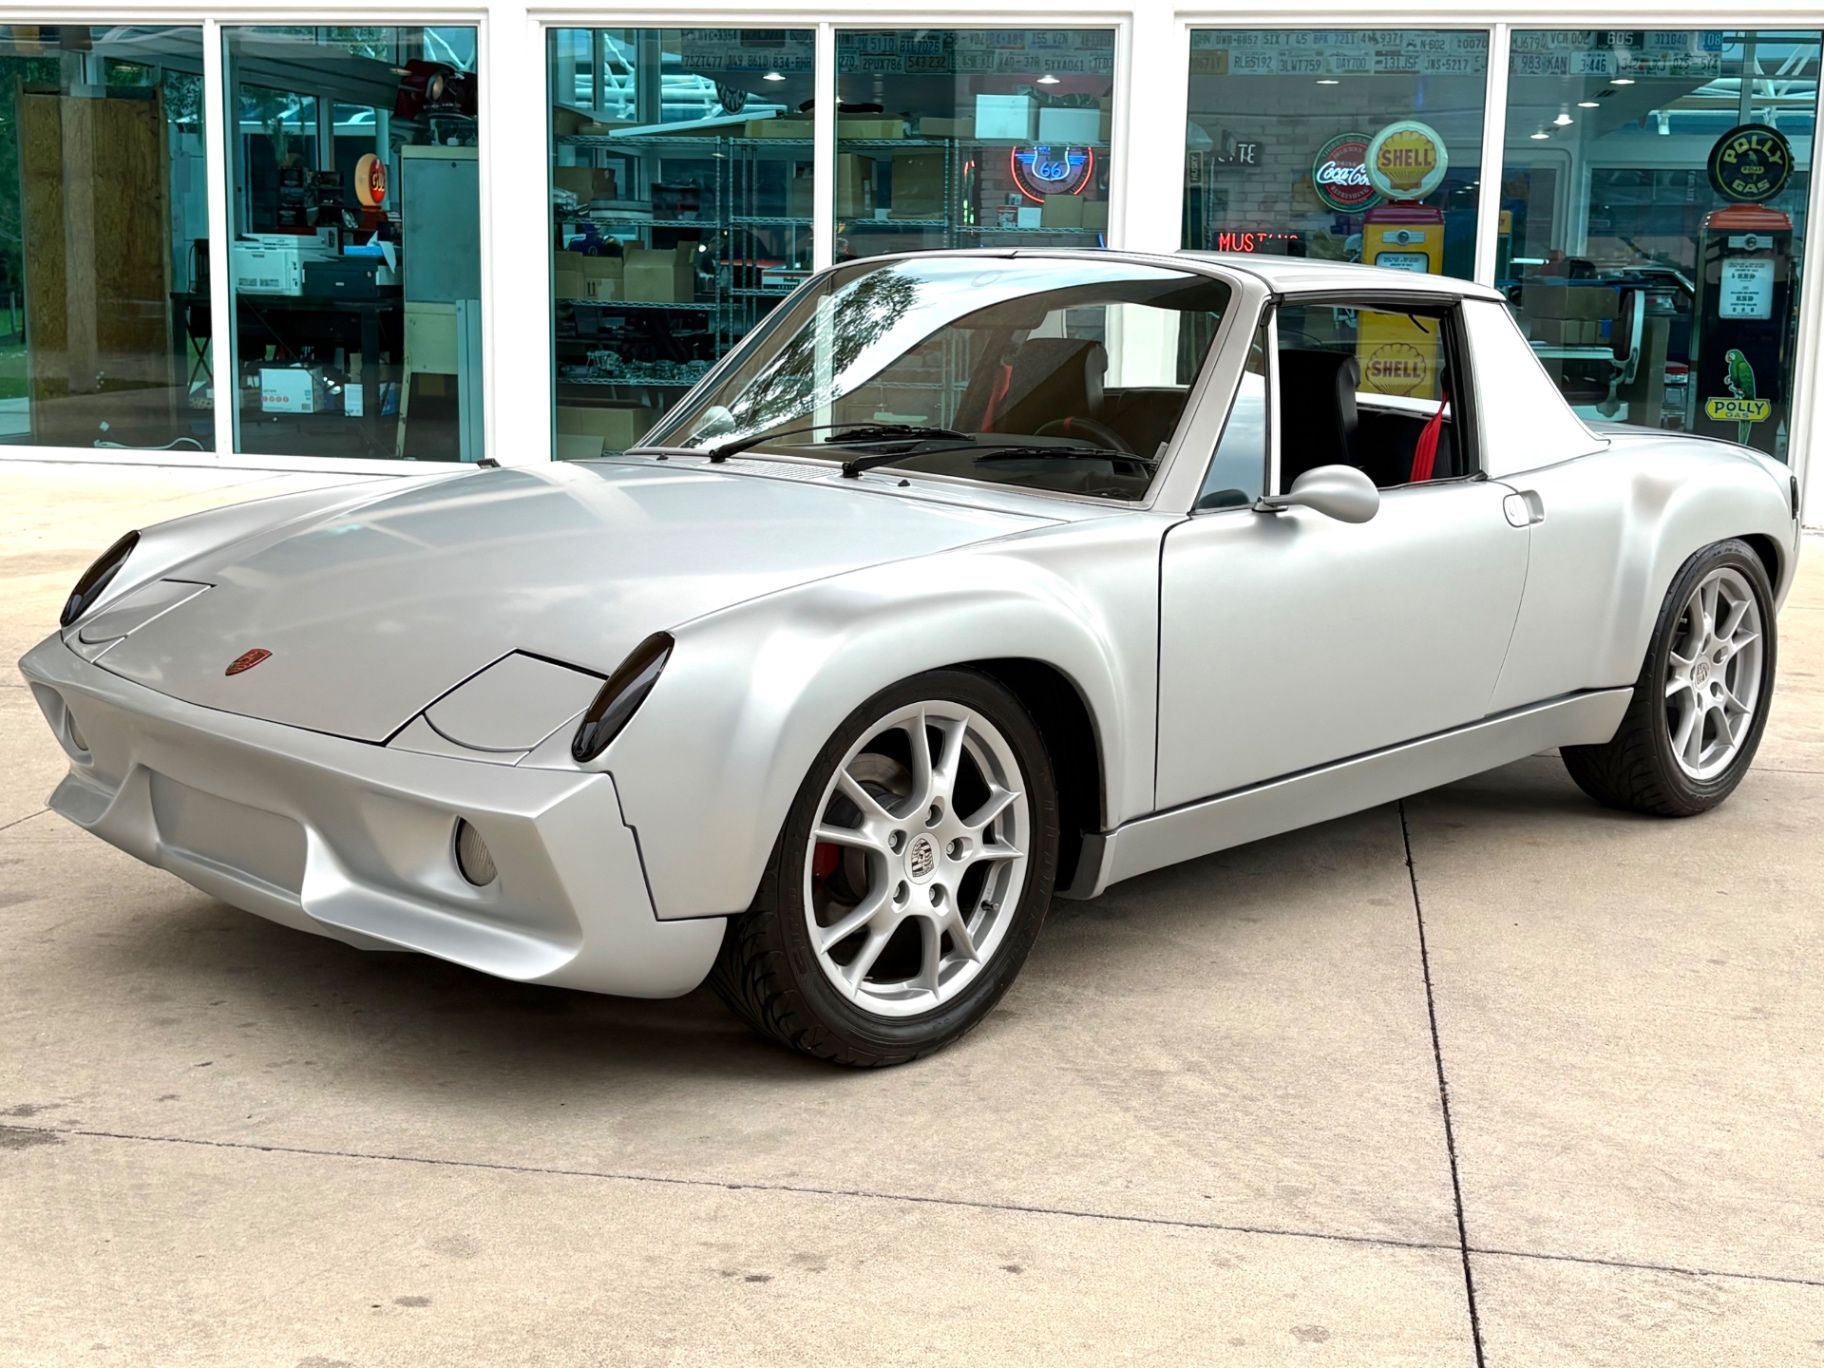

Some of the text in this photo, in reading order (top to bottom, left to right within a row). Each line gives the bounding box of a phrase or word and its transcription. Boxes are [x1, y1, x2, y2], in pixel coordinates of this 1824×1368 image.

[1607, 32, 1633, 45] 605
[1382, 148, 1432, 168] SHELL
[1723, 135, 1783, 164] POLLY
[1040, 162, 1062, 177] 66
[1316, 161, 1371, 186] Coca-Co
[1732, 179, 1770, 193] GAS
[1371, 360, 1421, 379] SHELL
[1714, 401, 1764, 415] POLLY
